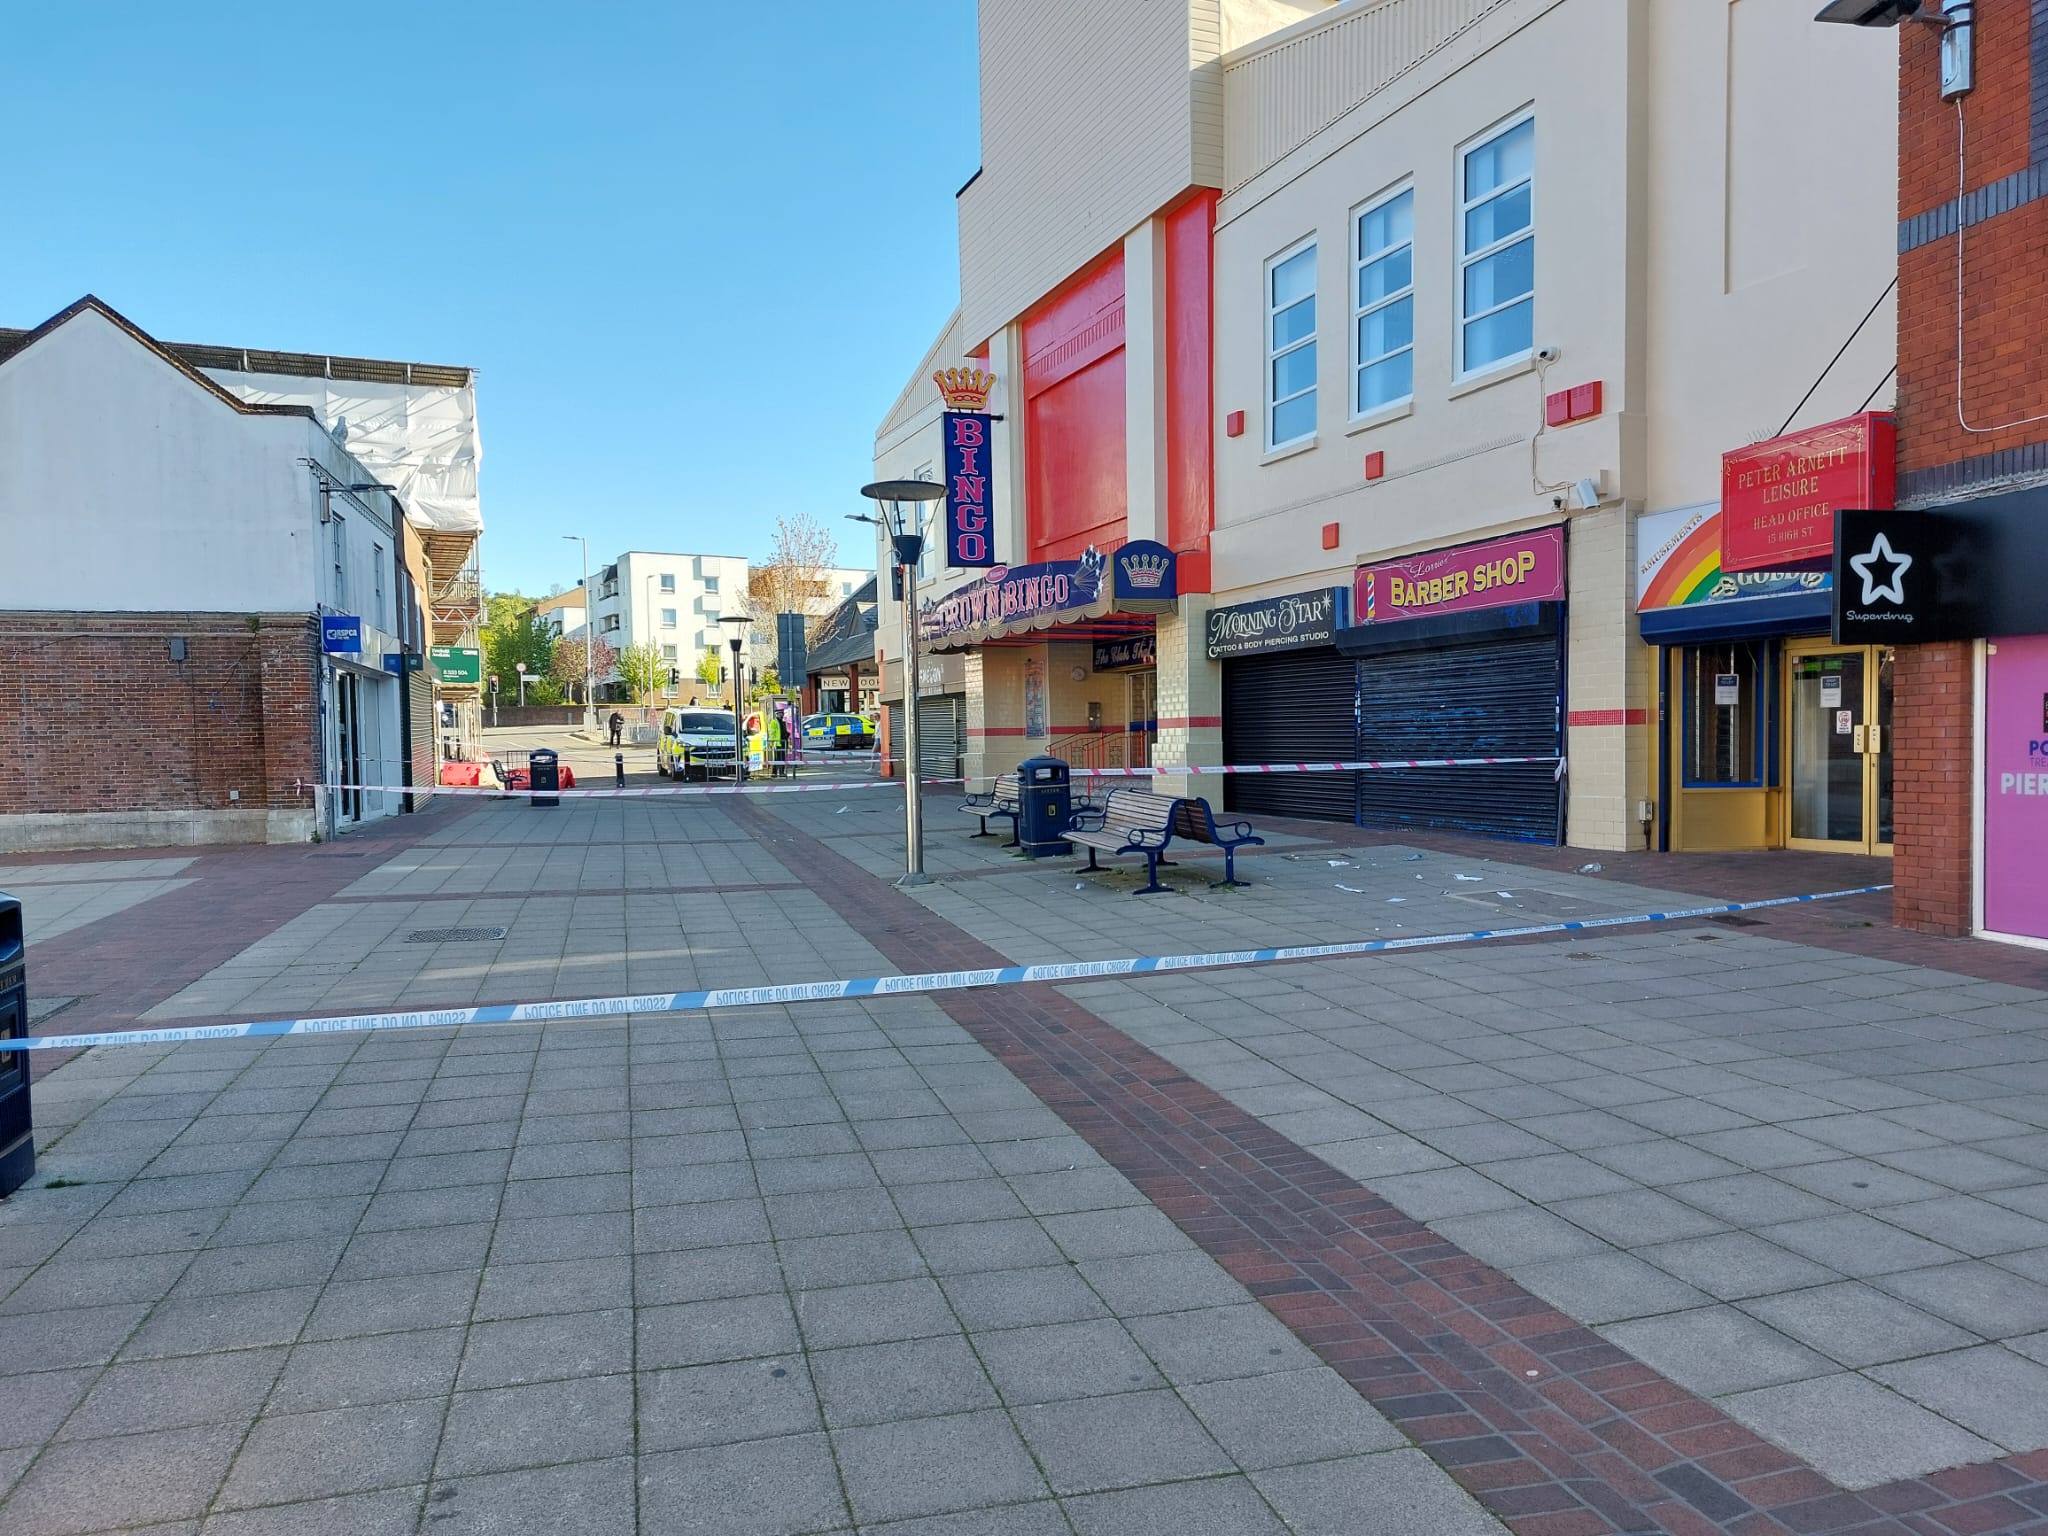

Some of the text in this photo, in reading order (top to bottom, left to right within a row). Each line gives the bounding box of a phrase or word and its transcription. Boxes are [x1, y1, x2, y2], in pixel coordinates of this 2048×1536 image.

[1738, 446, 1847, 489] PETER ARNETT
[952, 418, 988, 561] BINGO
[1763, 476, 1819, 504] LEISURE
[1753, 502, 1829, 530] HEAD OFFICE
[1640, 511, 1703, 575] AMUSEMENTS
[1779, 529, 1799, 542] HIGH
[1801, 526, 1814, 537] ST
[1390, 550, 1536, 607] BARBER SHOP
[938, 573, 1070, 632] CROWN BINGO
[1846, 610, 1915, 623] Superdrug
[1209, 598, 1323, 644] MORNING STAR
[1213, 643, 1237, 652] TATTOO
[1244, 640, 1263, 649] BODY
[1264, 635, 1298, 647] PIERCING
[1300, 631, 1329, 642] STUDIO
[823, 679, 849, 687] NEW
[2030, 758, 2048, 768] TRE
[2001, 773, 2048, 795] PIER
